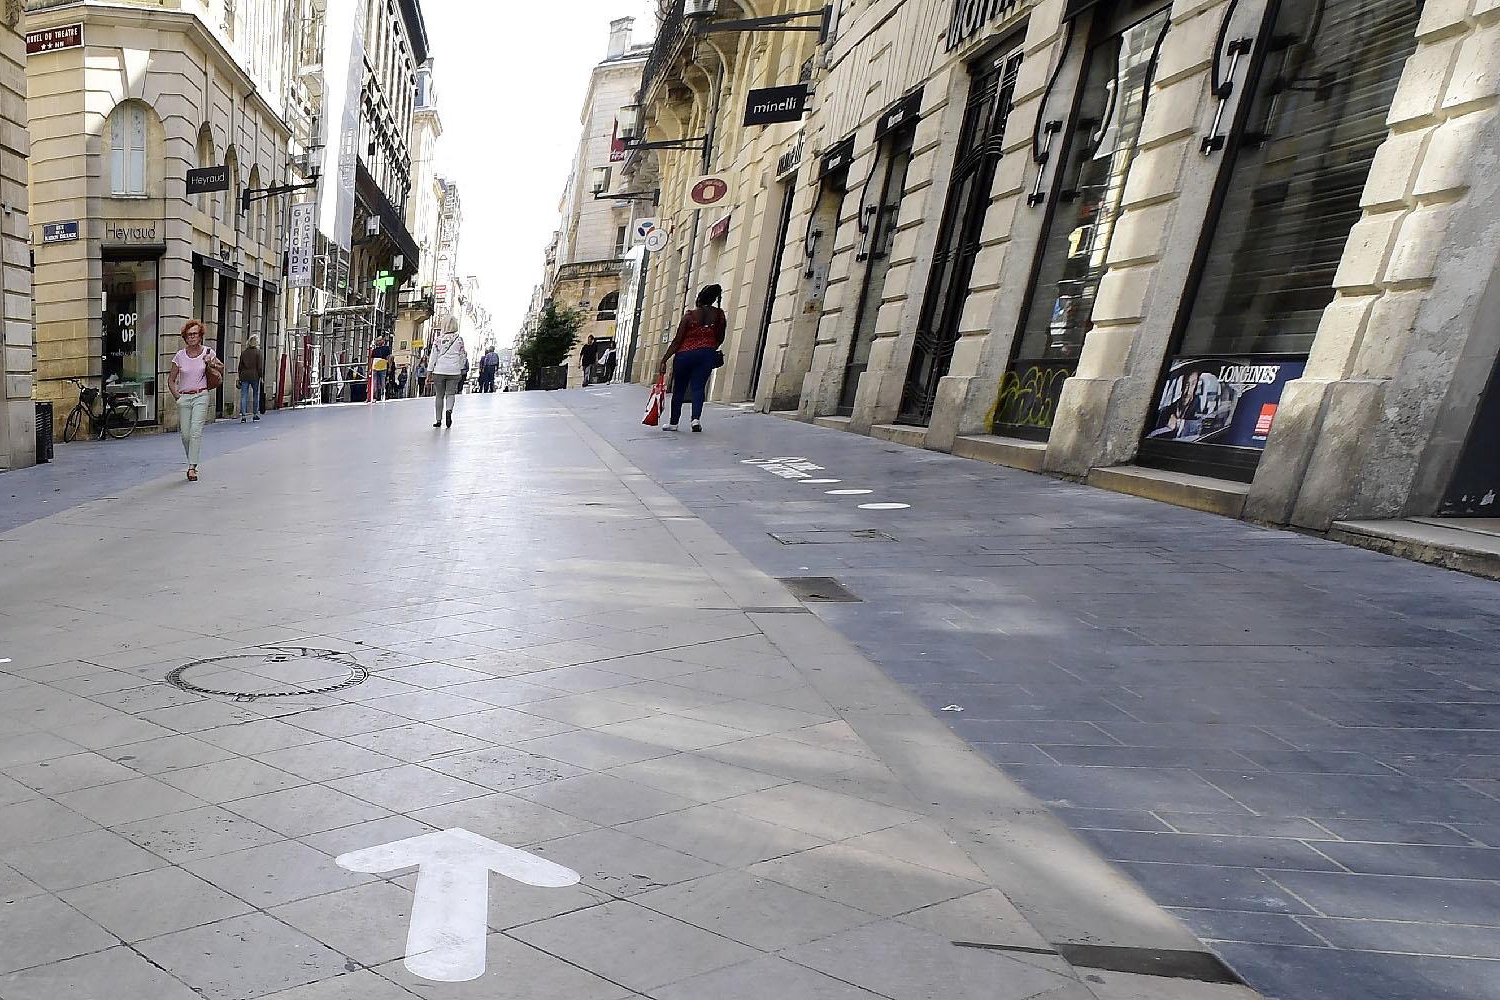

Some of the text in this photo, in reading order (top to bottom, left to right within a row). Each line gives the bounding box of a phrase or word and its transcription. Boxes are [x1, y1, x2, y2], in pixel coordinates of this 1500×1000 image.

[752, 96, 798, 115] minelli
[191, 171, 226, 186] Heyraud
[104, 220, 157, 244] Heyraud
[291, 209, 301, 274] GIRONDE
[301, 207, 311, 273] LOCATION
[118, 313, 138, 327] POP
[121, 329, 135, 342] UP
[1218, 365, 1281, 385] LONGINES
